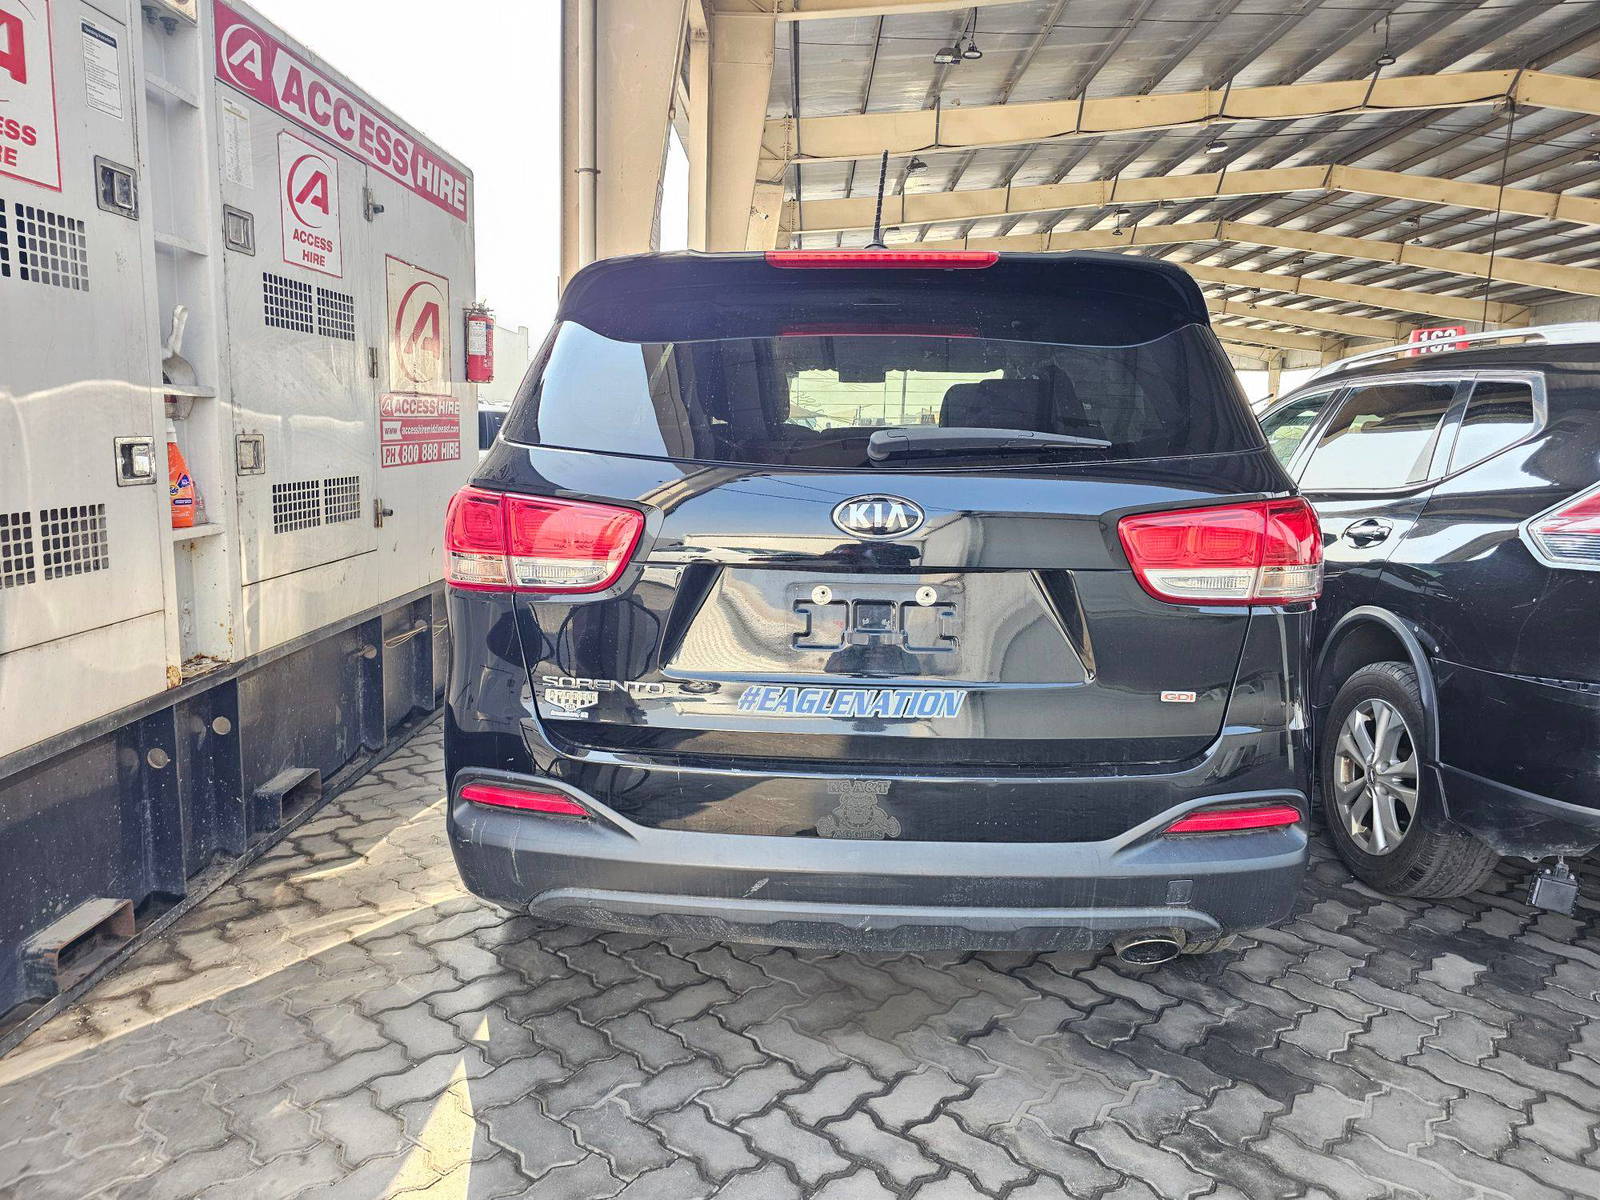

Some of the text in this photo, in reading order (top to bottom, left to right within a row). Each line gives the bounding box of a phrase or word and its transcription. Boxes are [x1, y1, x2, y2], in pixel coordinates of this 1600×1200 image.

[281, 64, 409, 177] ACCESS
[416, 153, 467, 212] HIRE
[292, 229, 333, 253] ACCESS
[302, 249, 326, 267] HIRE
[394, 398, 436, 415] ACCESS
[438, 400, 460, 415] HIRE
[385, 442, 460, 464] PH 800 888 HIRE
[848, 503, 909, 528] KIA
[542, 675, 664, 694] SORENTO
[737, 685, 968, 719] #EAGLENATION
